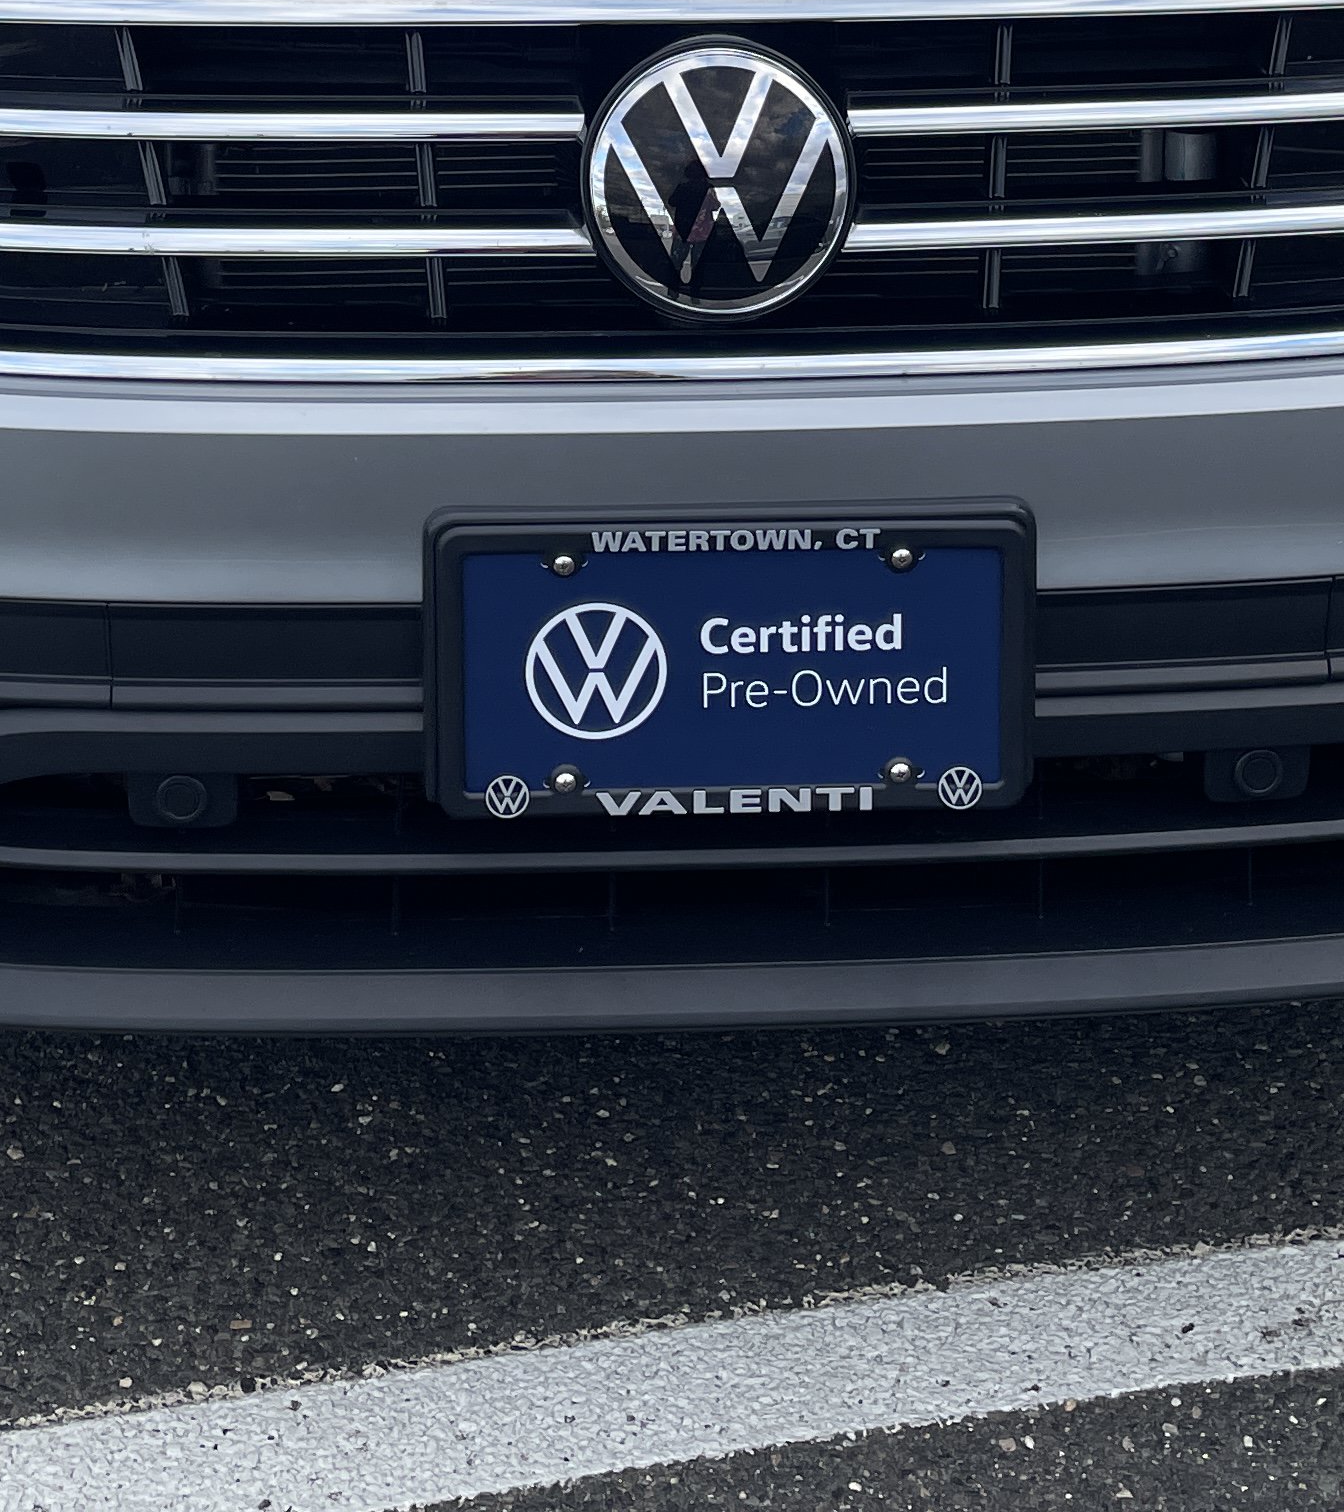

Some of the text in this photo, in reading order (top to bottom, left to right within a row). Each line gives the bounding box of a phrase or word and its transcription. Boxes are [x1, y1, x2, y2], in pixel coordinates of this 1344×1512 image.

[588, 46, 849, 315] VW
[591, 527, 882, 553] WATERTOWN, CT
[700, 613, 903, 655] Certified
[525, 602, 668, 740] VW
[702, 666, 948, 709] Pre-Owned
[485, 775, 530, 819] VW
[596, 786, 873, 817] VALENTI
[938, 766, 983, 810] VW
